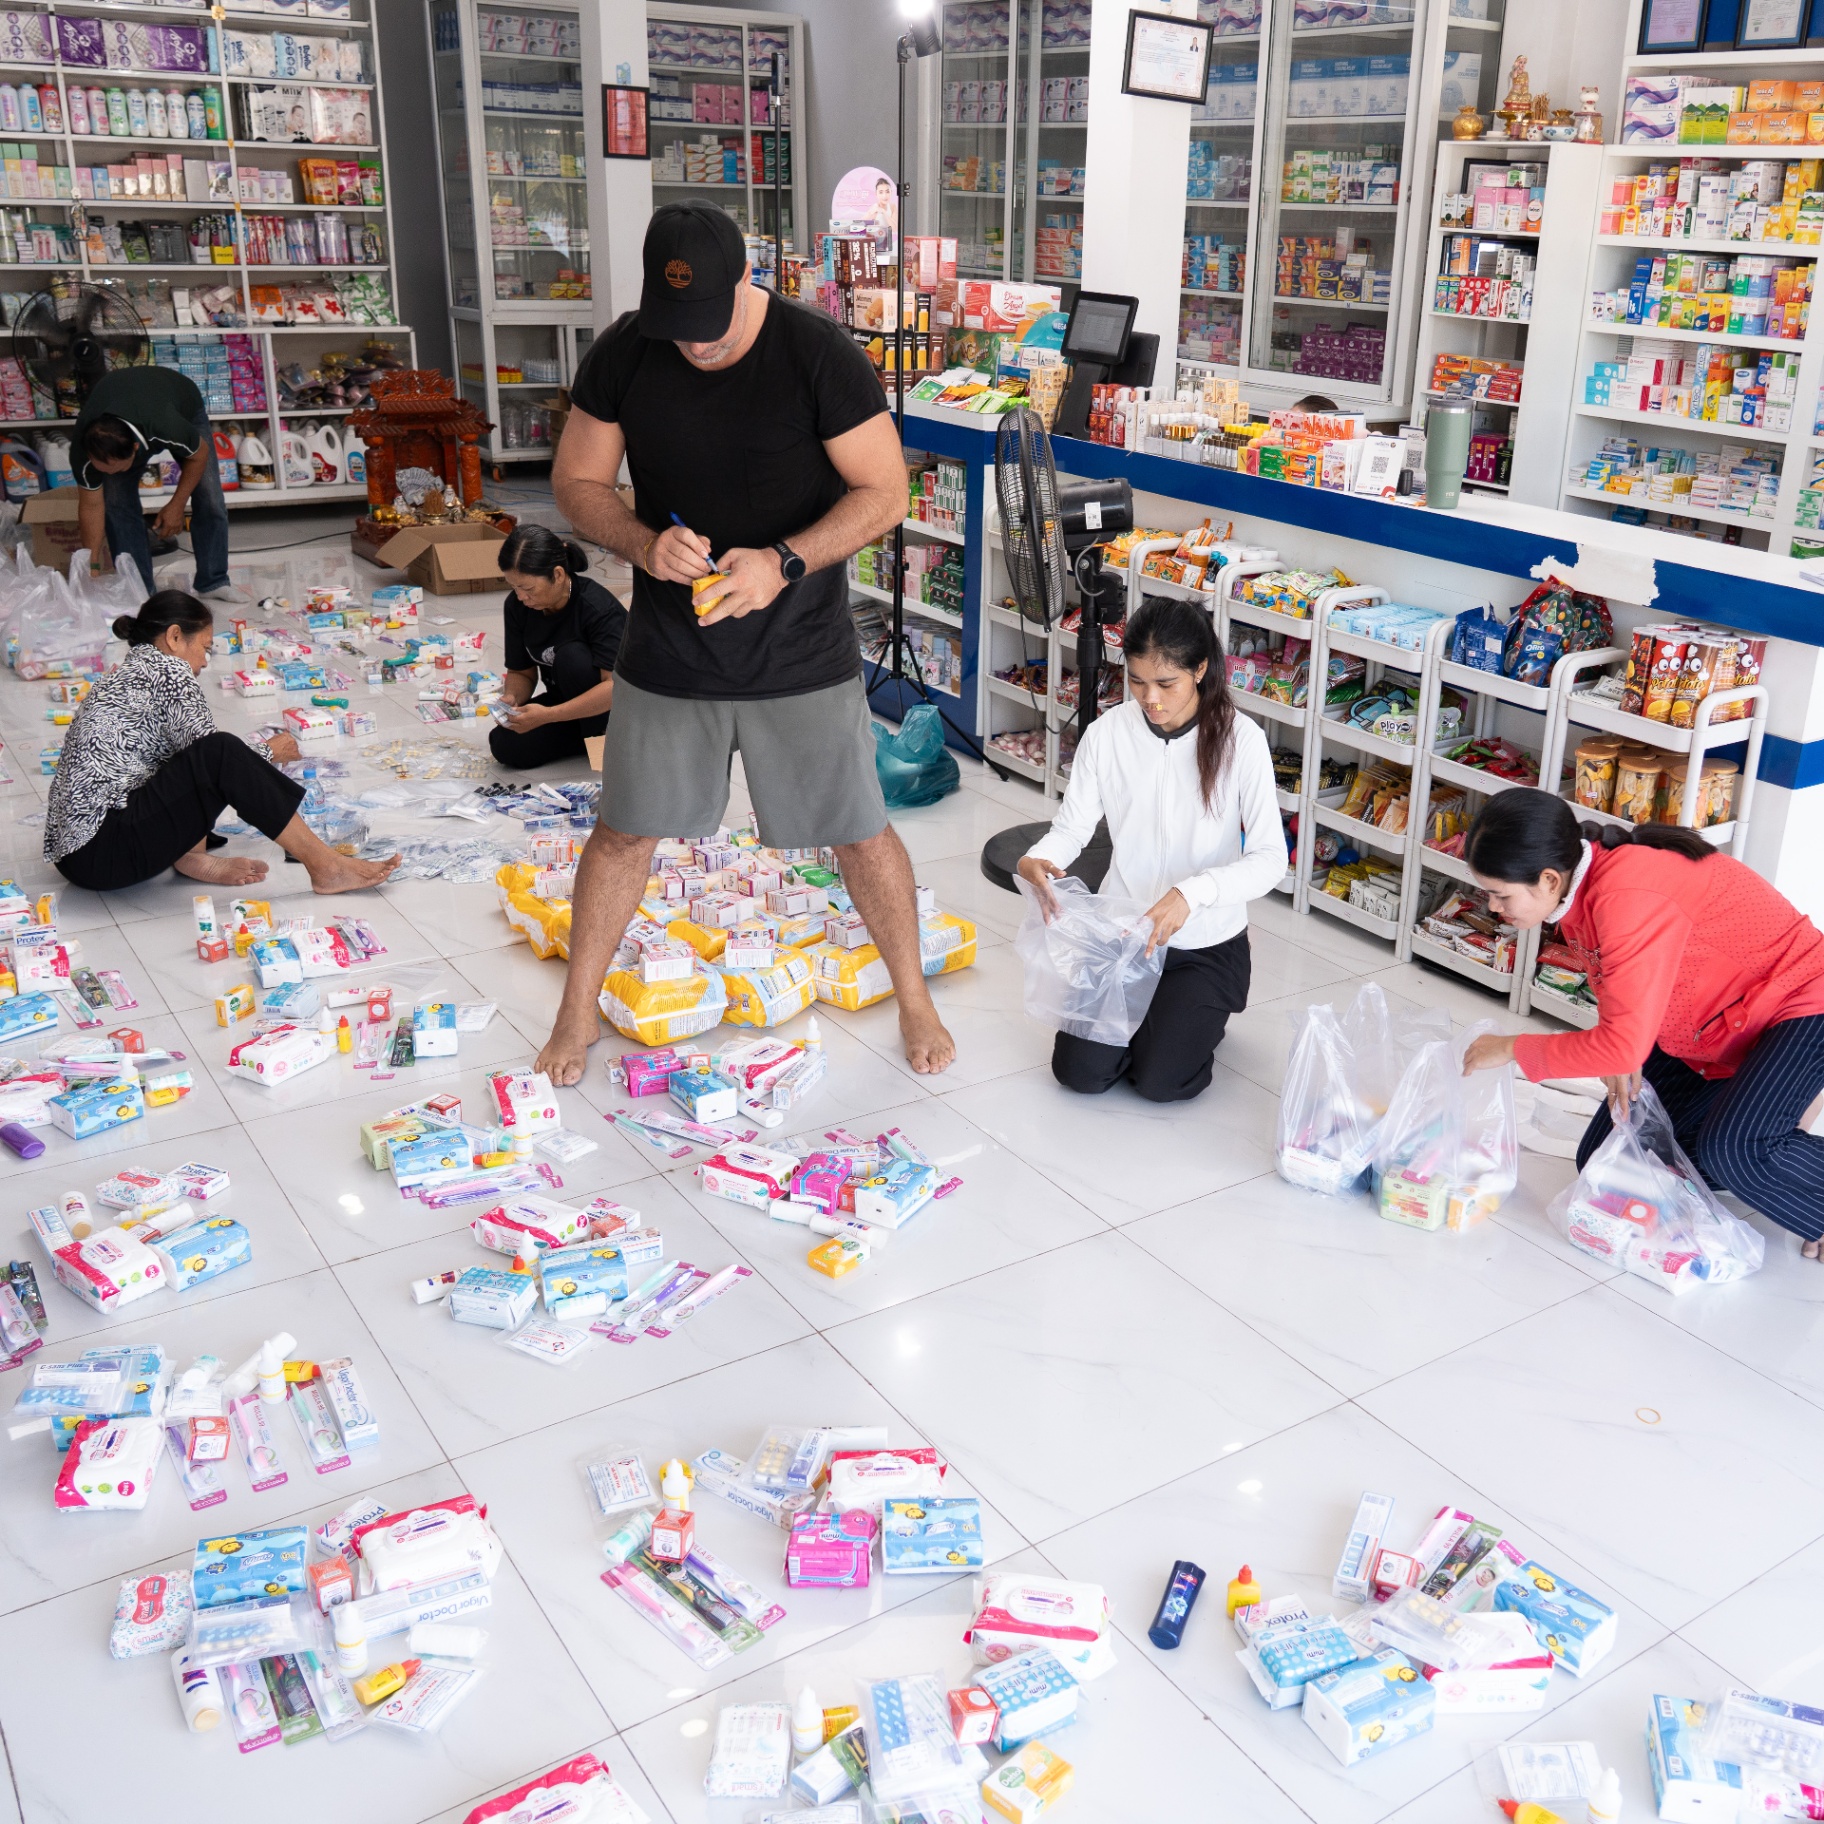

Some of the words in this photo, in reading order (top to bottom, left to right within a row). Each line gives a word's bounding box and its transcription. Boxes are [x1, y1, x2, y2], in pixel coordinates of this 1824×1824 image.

[16, 934, 46, 945] Protex
[463, 1595, 488, 1608] Vigor
[419, 1604, 458, 1622] Doctor
[1264, 1610, 1308, 1628] Protex
[1731, 1689, 1761, 1702] C-sans
[1762, 1696, 1781, 1707] Plus
